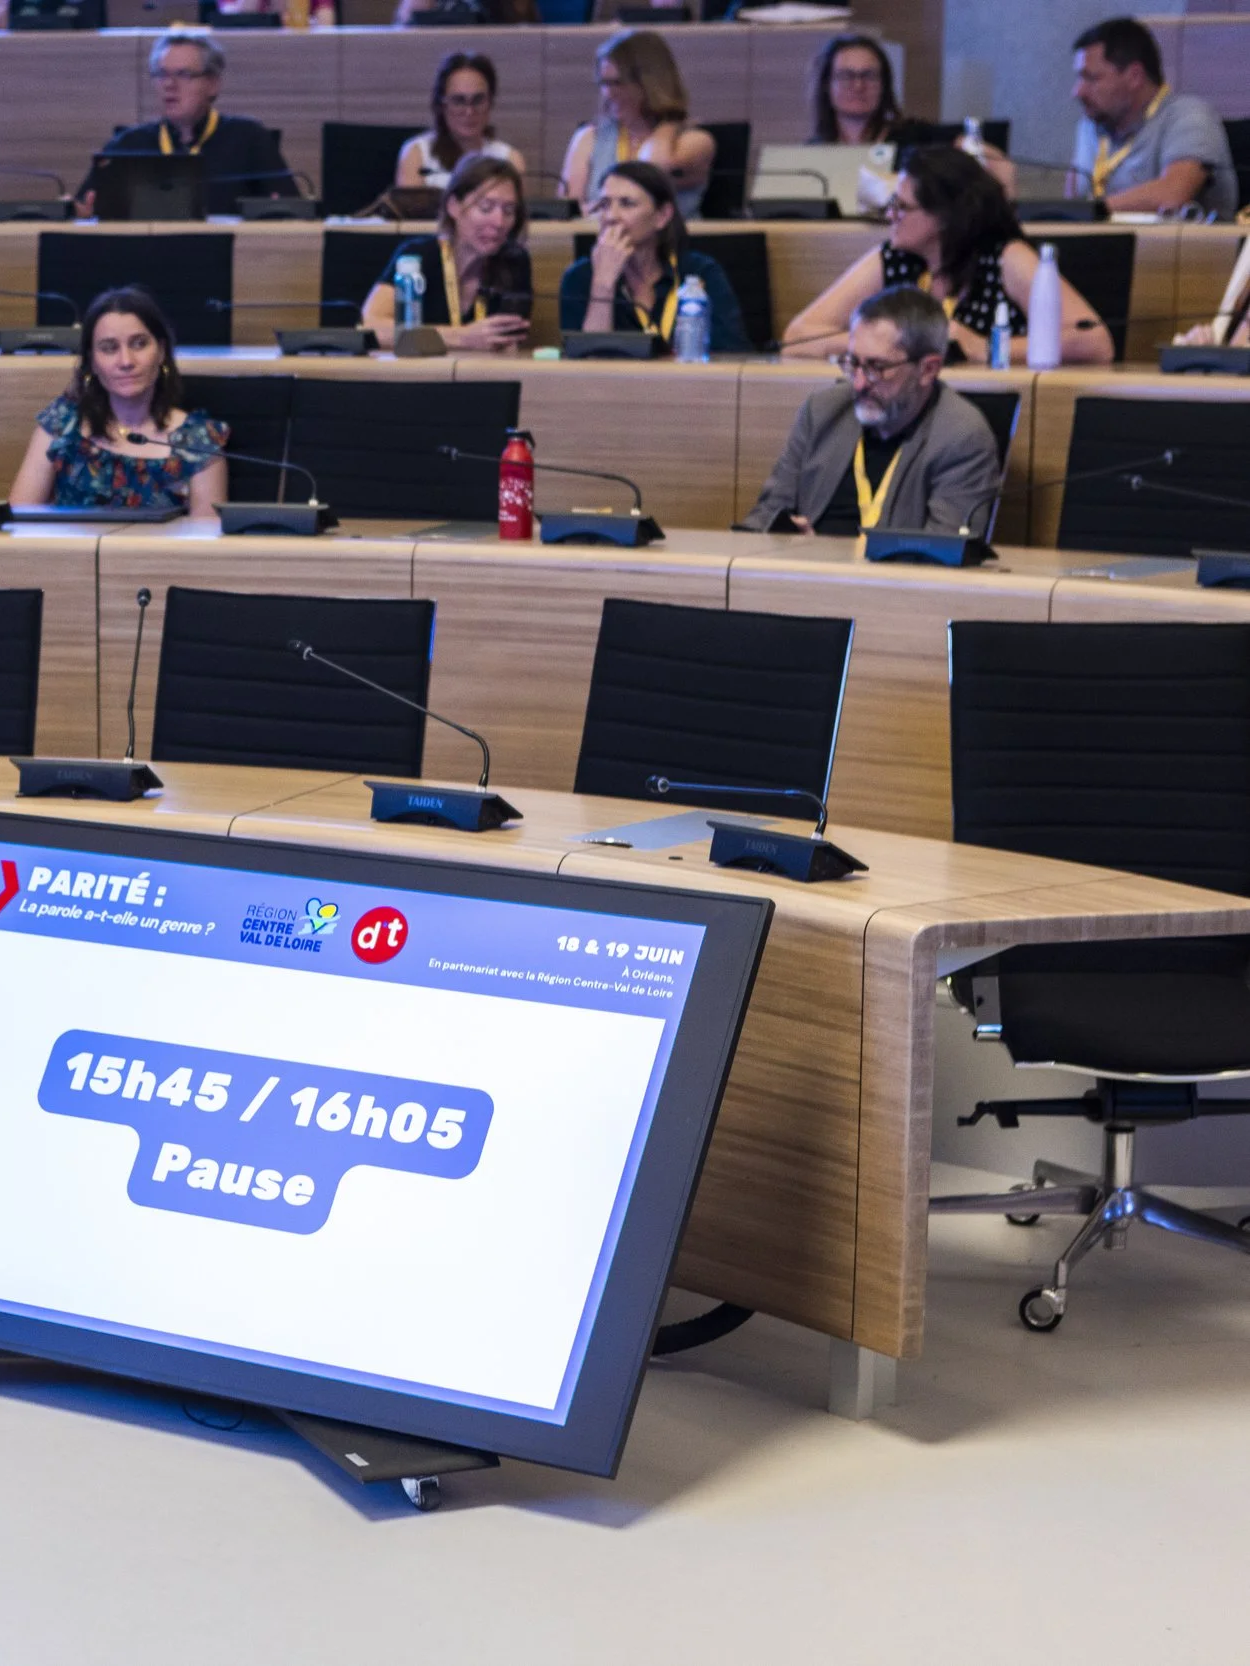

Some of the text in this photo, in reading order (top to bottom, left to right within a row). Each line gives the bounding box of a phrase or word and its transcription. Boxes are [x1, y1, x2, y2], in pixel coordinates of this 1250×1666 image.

[407, 794, 443, 809] TAIDEN
[26, 865, 151, 907] PARITÉ
[19, 899, 36, 914] La
[36, 901, 83, 920] parole
[84, 907, 137, 927] a-t-elle
[140, 916, 159, 929] un
[159, 920, 202, 935] genre
[242, 917, 295, 935] CENTRE
[246, 903, 298, 922] RÉGION
[239, 931, 323, 953] VAL DE LOIRE
[556, 936, 685, 966] 18 & 19 JUIN
[428, 957, 674, 999] En partenariat avec la Région Centre-Val de Loire
[621, 965, 675, 985] À Orléans,
[66, 1052, 233, 1113] 15h45
[290, 1086, 467, 1150] 16h05
[151, 1142, 316, 1207] Pause
